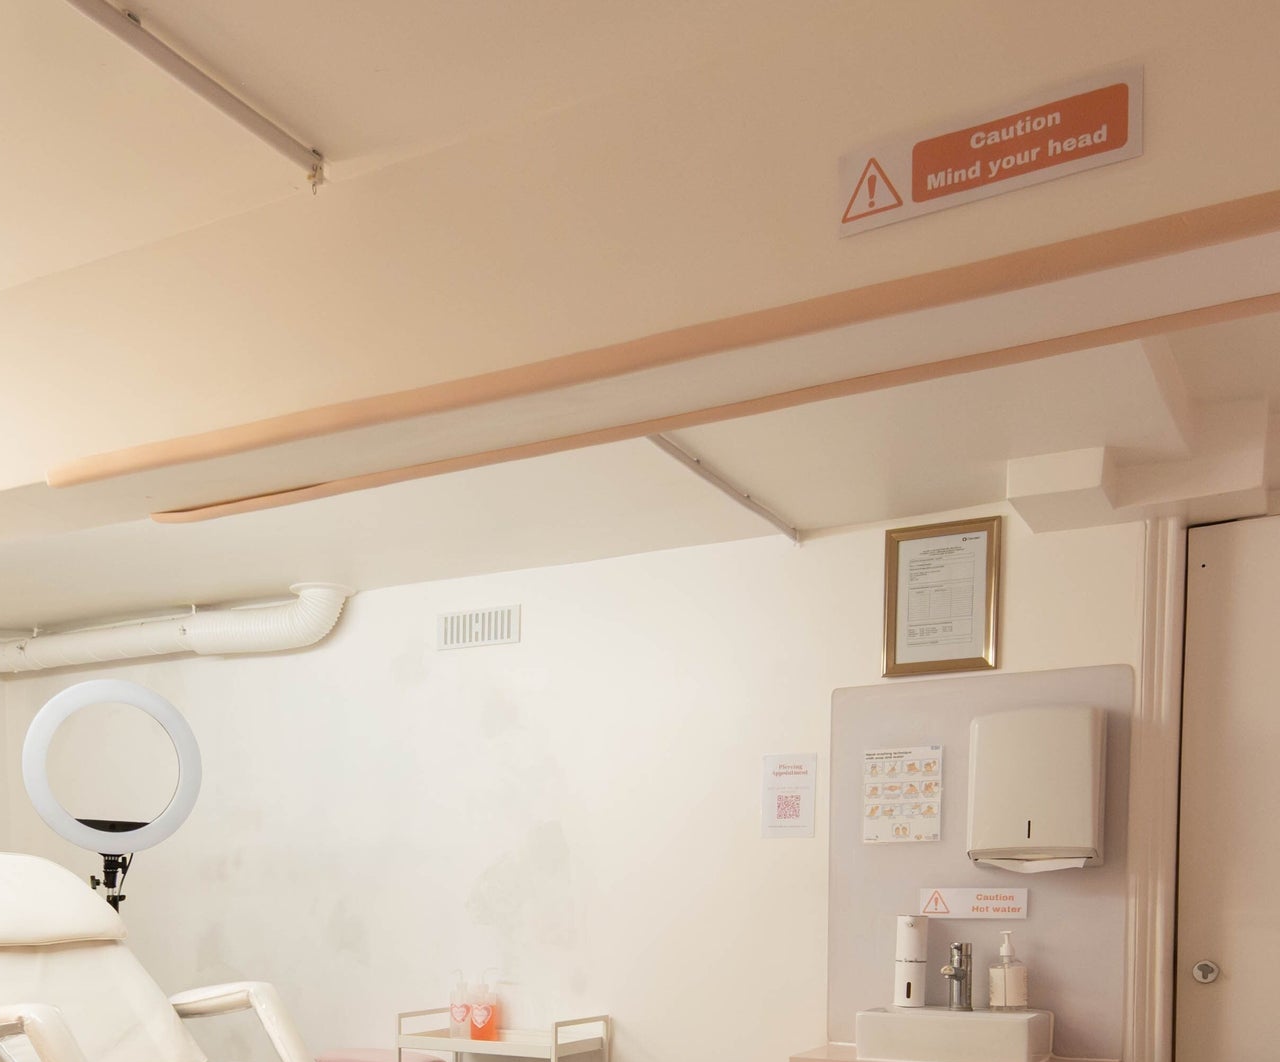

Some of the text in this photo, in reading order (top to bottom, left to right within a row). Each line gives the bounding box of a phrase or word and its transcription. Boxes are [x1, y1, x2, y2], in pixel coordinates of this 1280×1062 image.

[970, 110, 1061, 149] Caution
[926, 124, 1108, 191] Mind your head
[971, 905, 989, 913] Hot
[975, 893, 1015, 902] Caution
